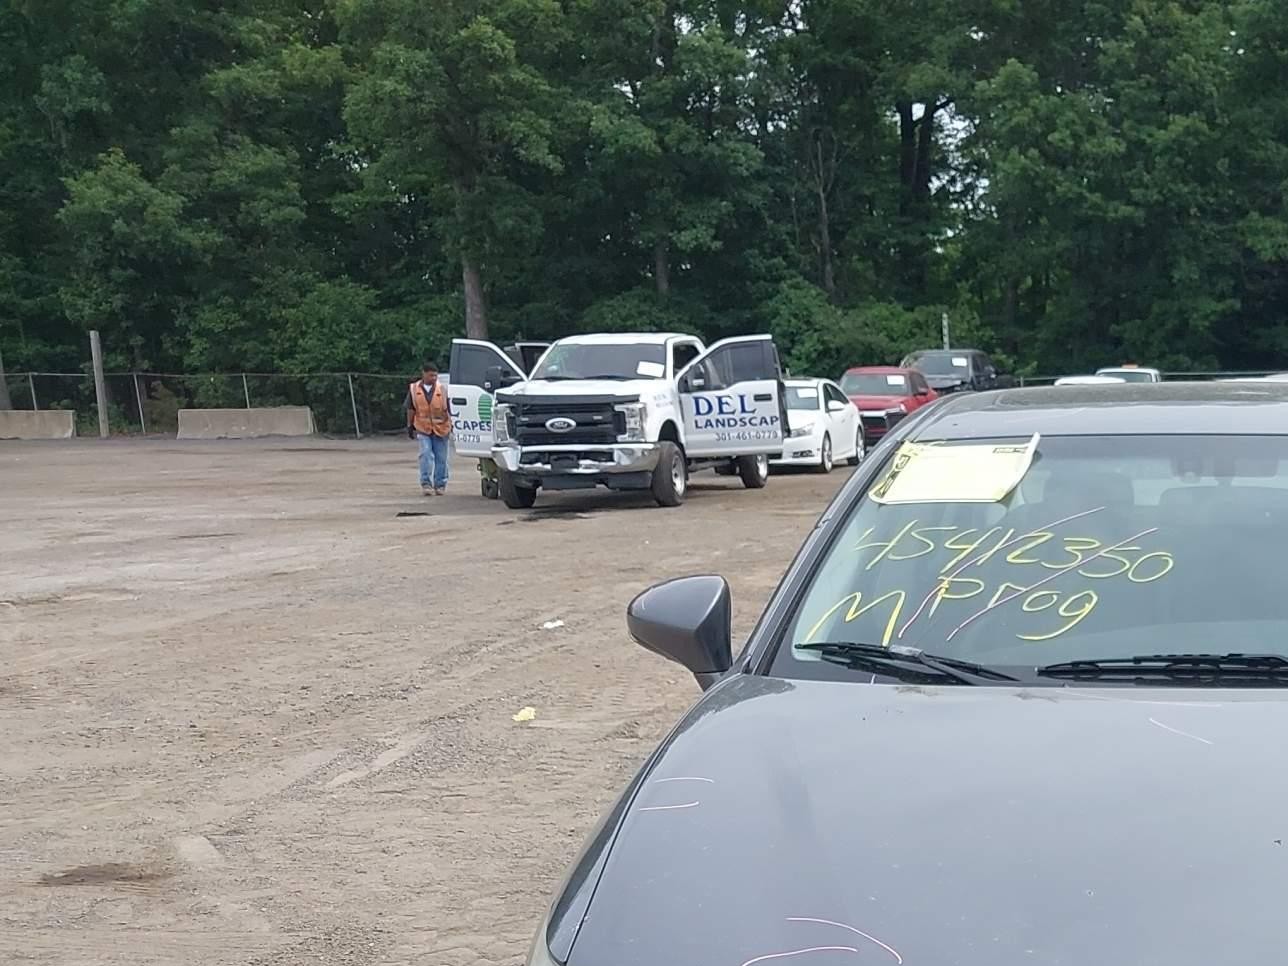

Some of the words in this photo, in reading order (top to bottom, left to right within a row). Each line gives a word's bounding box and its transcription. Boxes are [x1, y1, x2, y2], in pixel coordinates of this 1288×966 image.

[692, 394, 756, 416] DEL
[694, 415, 779, 430] LANDSCAP
[854, 519, 1174, 583] 45412350
